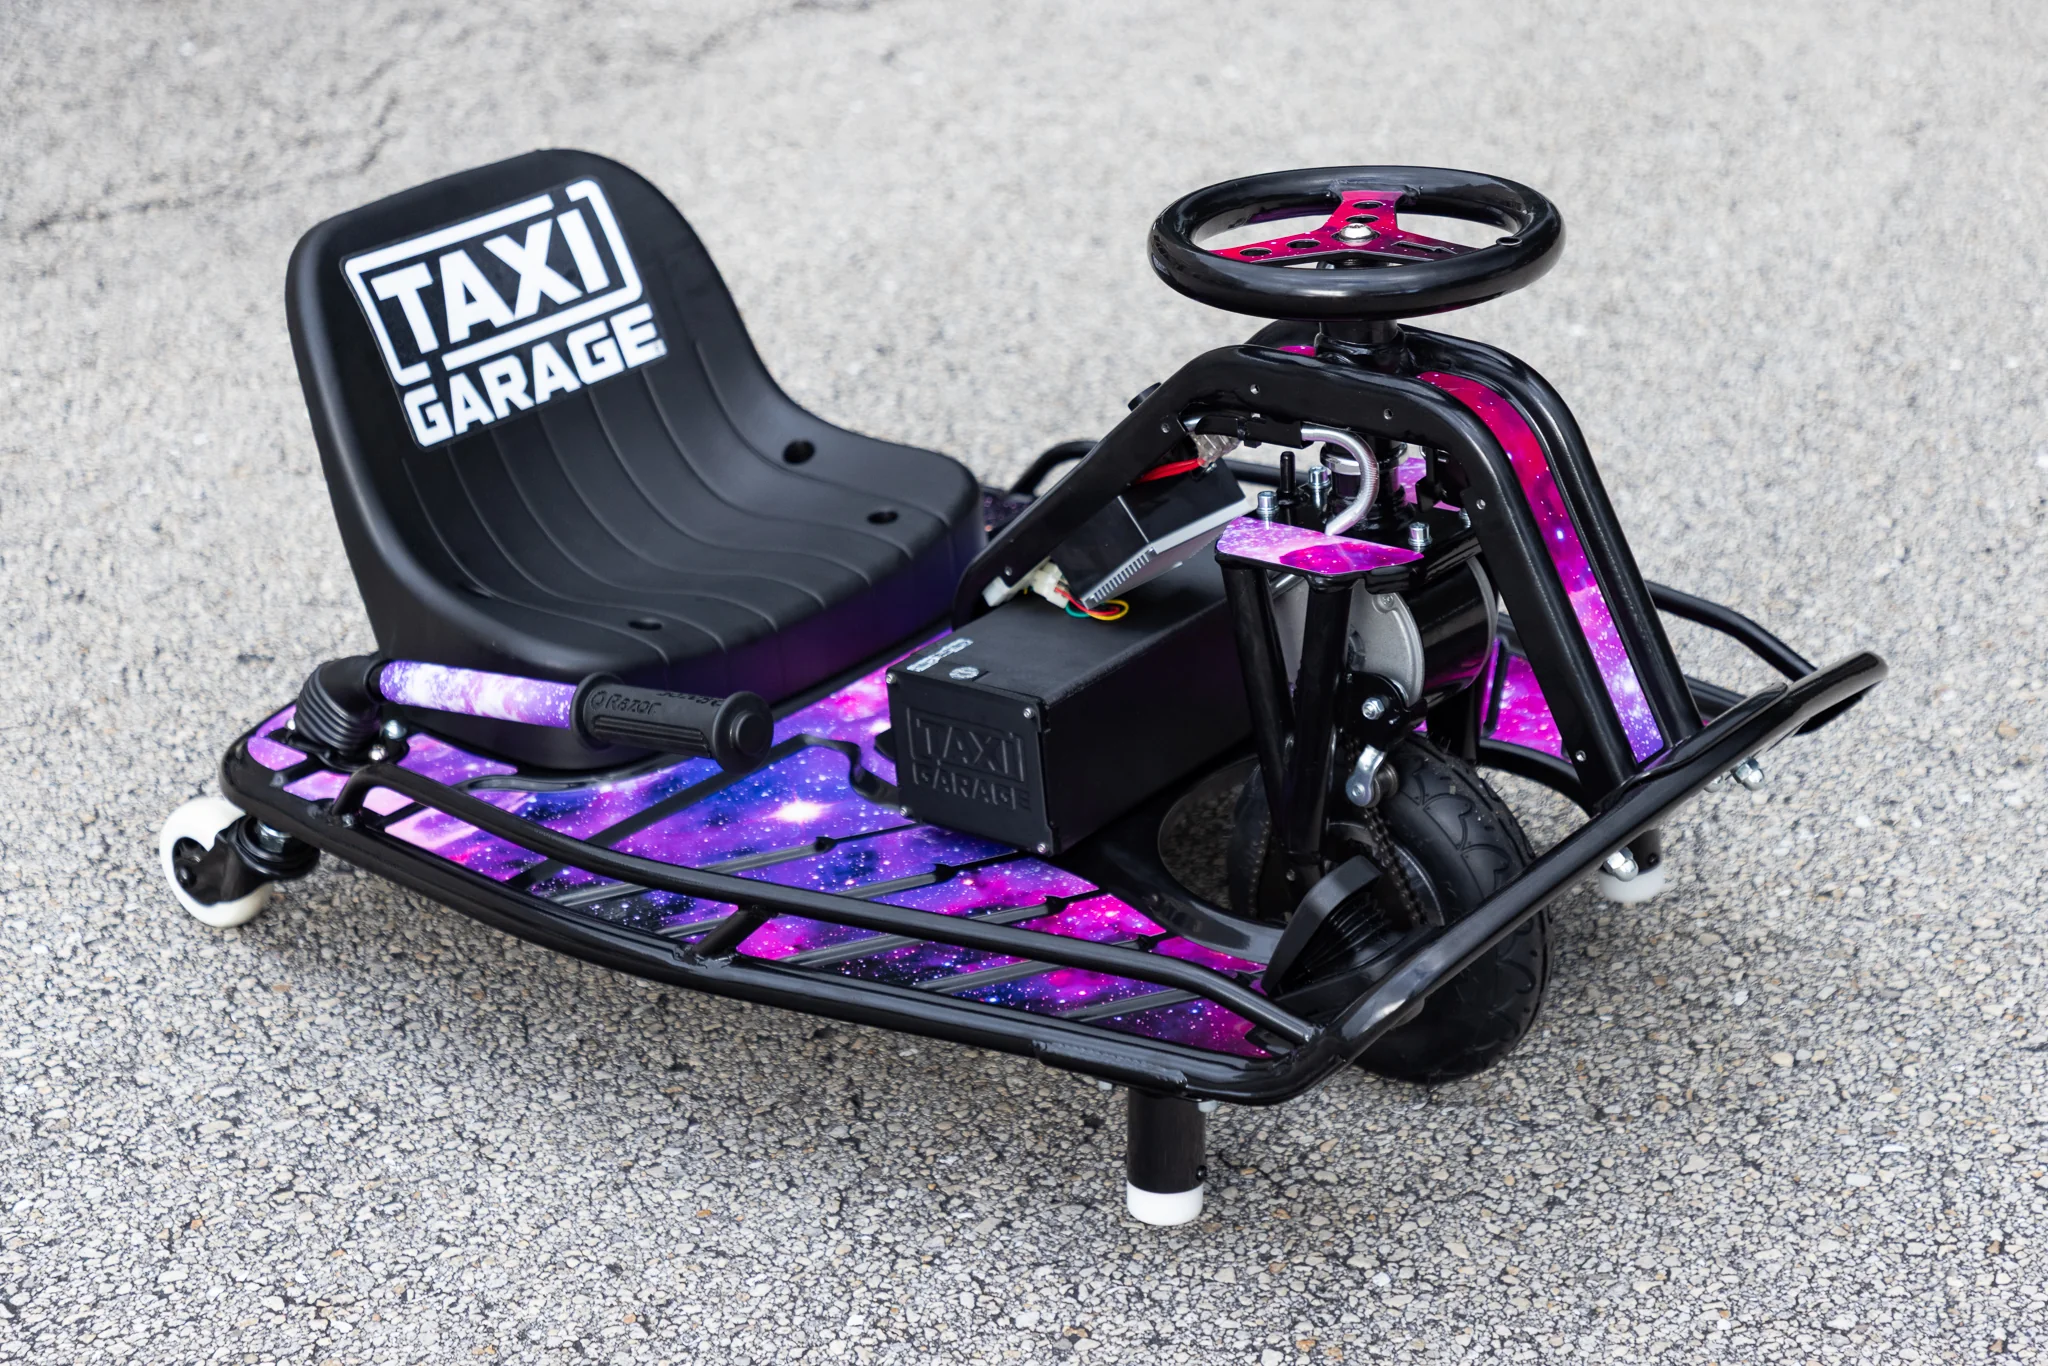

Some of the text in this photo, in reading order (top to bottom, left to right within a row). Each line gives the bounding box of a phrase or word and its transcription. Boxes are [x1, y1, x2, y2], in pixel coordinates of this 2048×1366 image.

[370, 207, 610, 355] TAXI
[402, 302, 668, 448] GARAGE
[911, 761, 1032, 813] GARAGE
[915, 716, 1018, 776] TAXI
